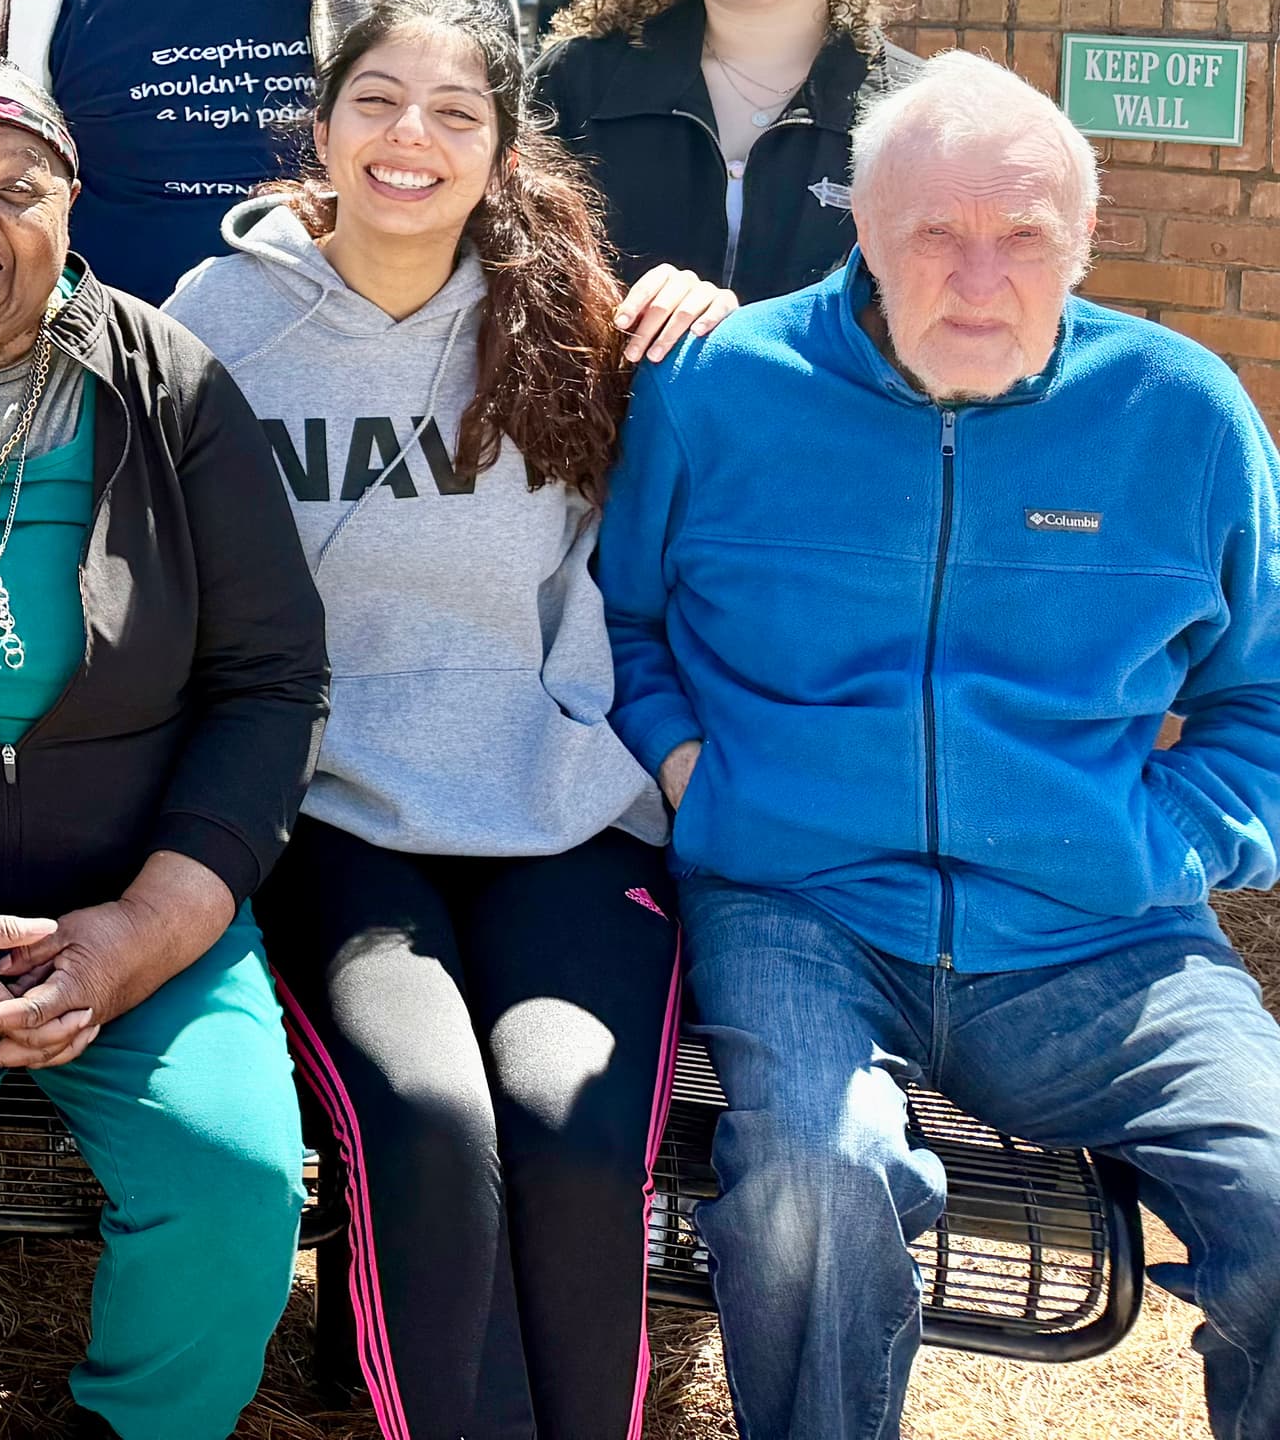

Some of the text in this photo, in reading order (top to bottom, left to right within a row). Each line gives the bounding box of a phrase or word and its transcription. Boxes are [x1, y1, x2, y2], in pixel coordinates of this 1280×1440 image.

[151, 36, 312, 68] Exceptional
[1084, 48, 1223, 88] KEEP OFF
[129, 71, 317, 101] shouldn't com
[156, 107, 177, 121] a
[184, 104, 250, 129] high
[1112, 93, 1190, 130] WALL
[164, 181, 253, 195] SMYRN
[1045, 513, 1099, 528] Columbia
